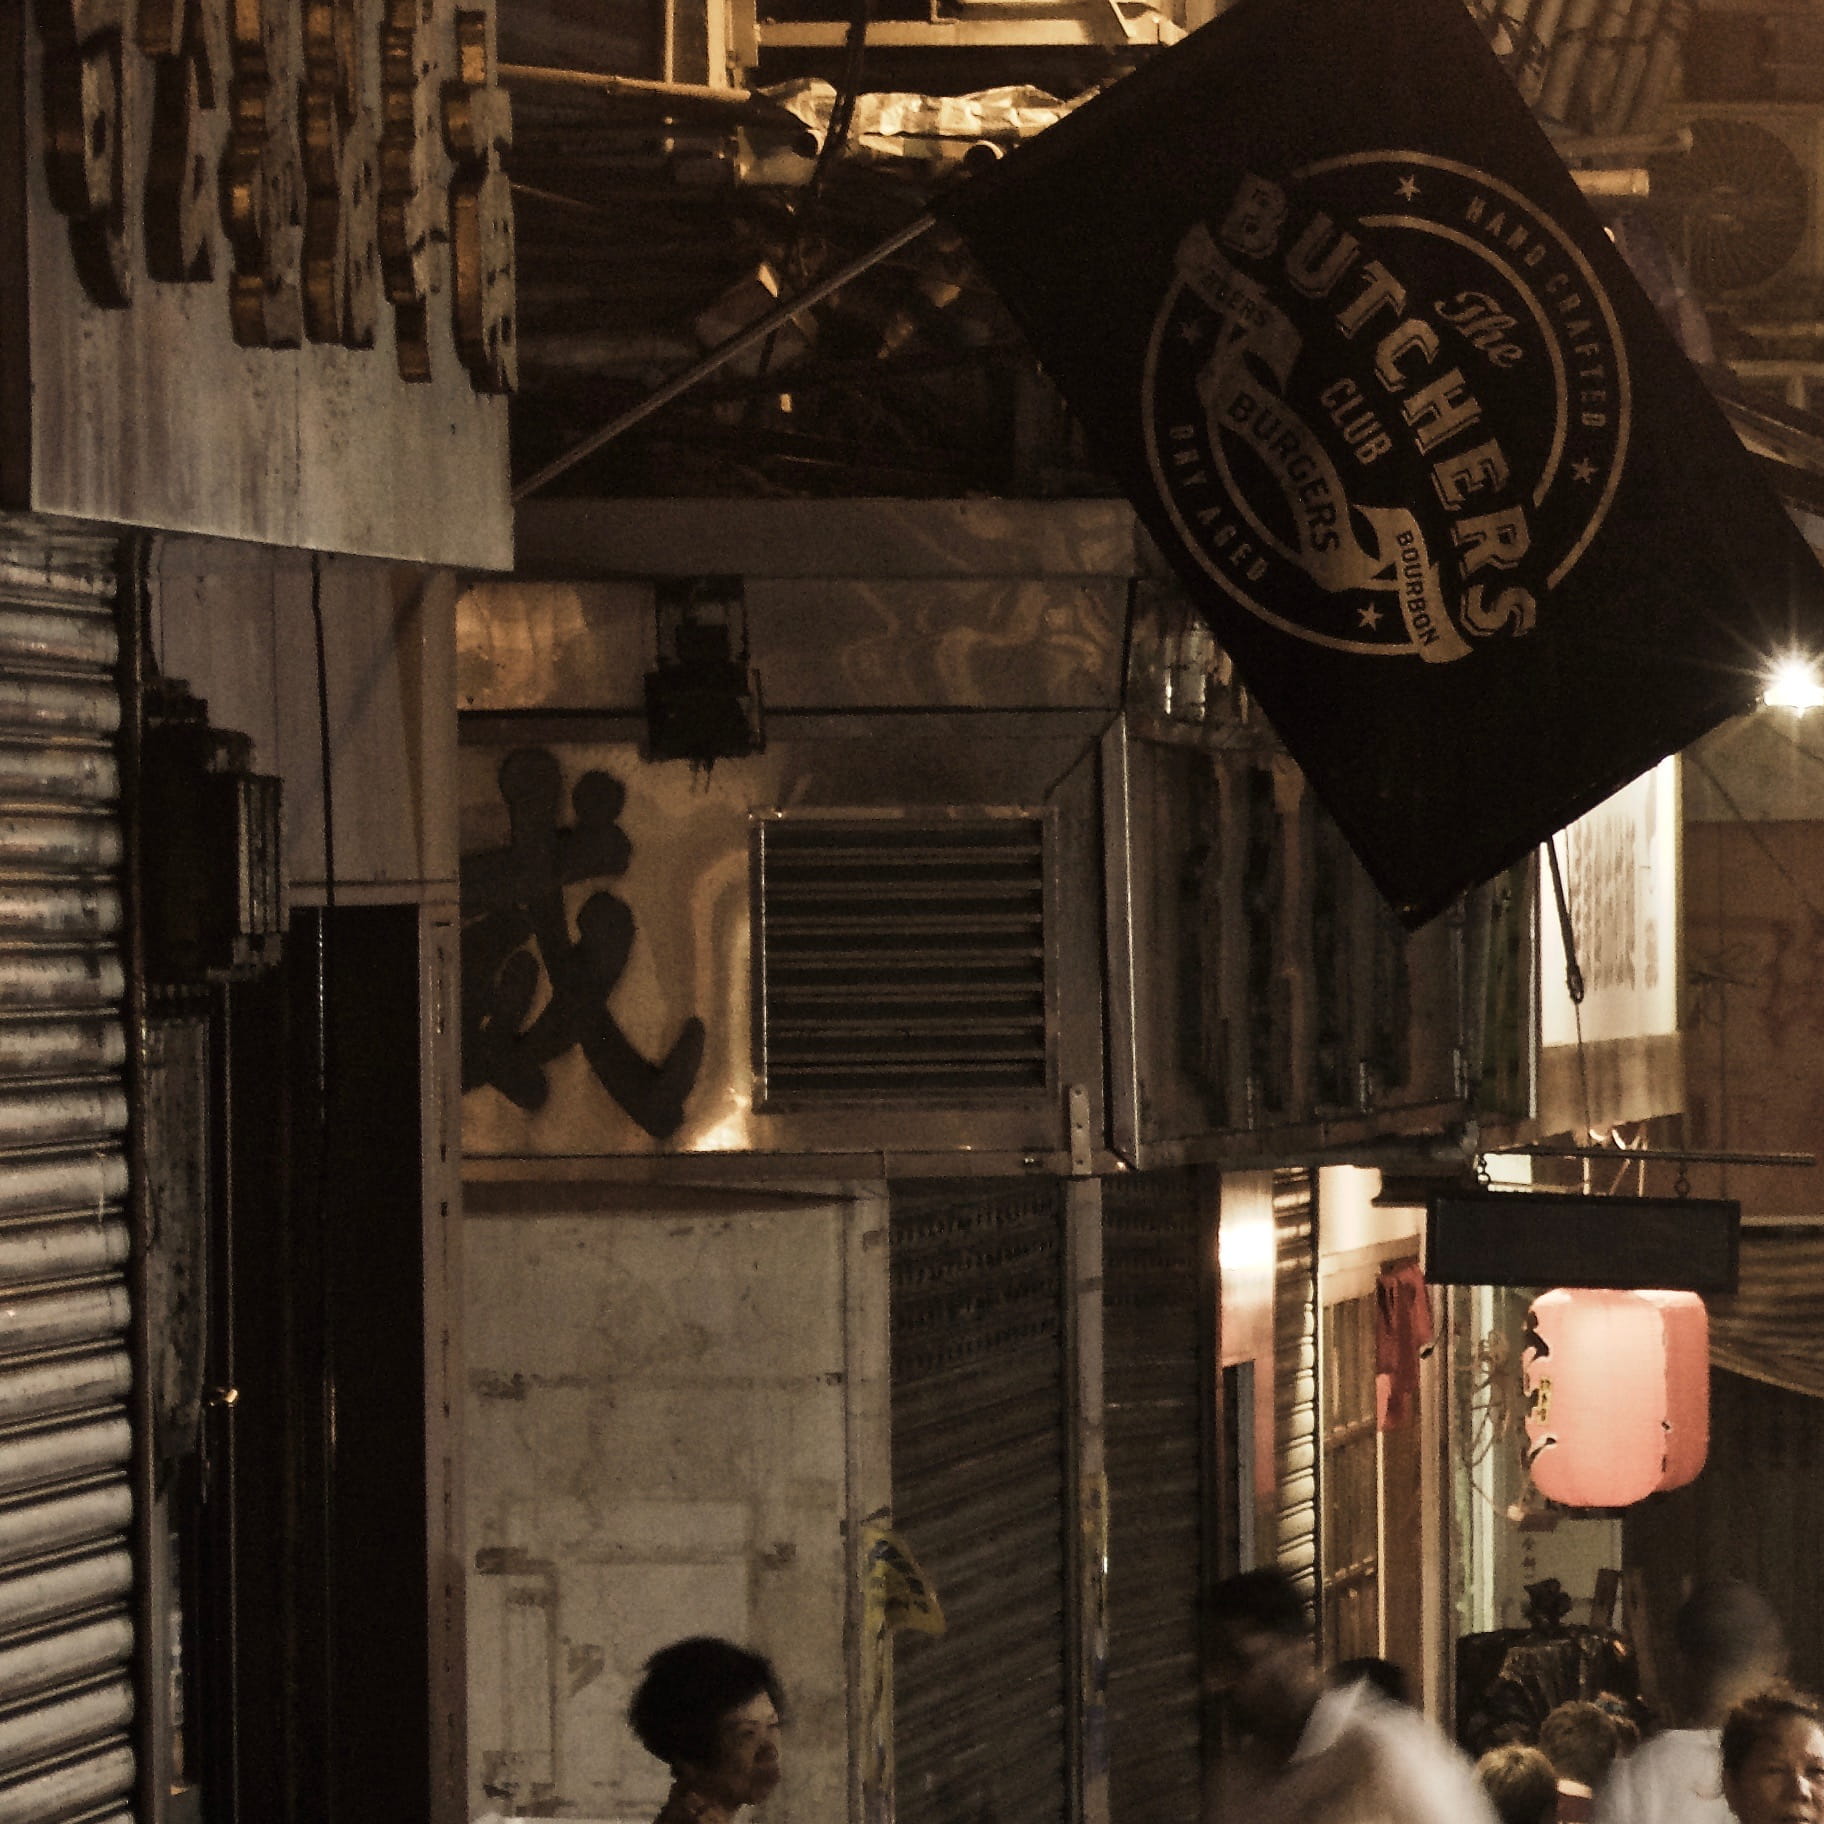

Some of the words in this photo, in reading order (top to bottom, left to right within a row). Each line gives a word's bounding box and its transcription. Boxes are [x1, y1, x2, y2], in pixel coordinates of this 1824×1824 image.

[1435, 291, 1524, 368] The
[1464, 195, 1549, 267] HAND
[1545, 272, 1609, 430] CRAFTED
[1217, 171, 1538, 639] BUTCHERS
[1227, 391, 1340, 553] BURGERS
[1320, 377, 1393, 466] CLUB
[1168, 423, 1209, 488] DRY
[1197, 506, 1269, 582] AGED
[1395, 529, 1440, 646] BOURBON
